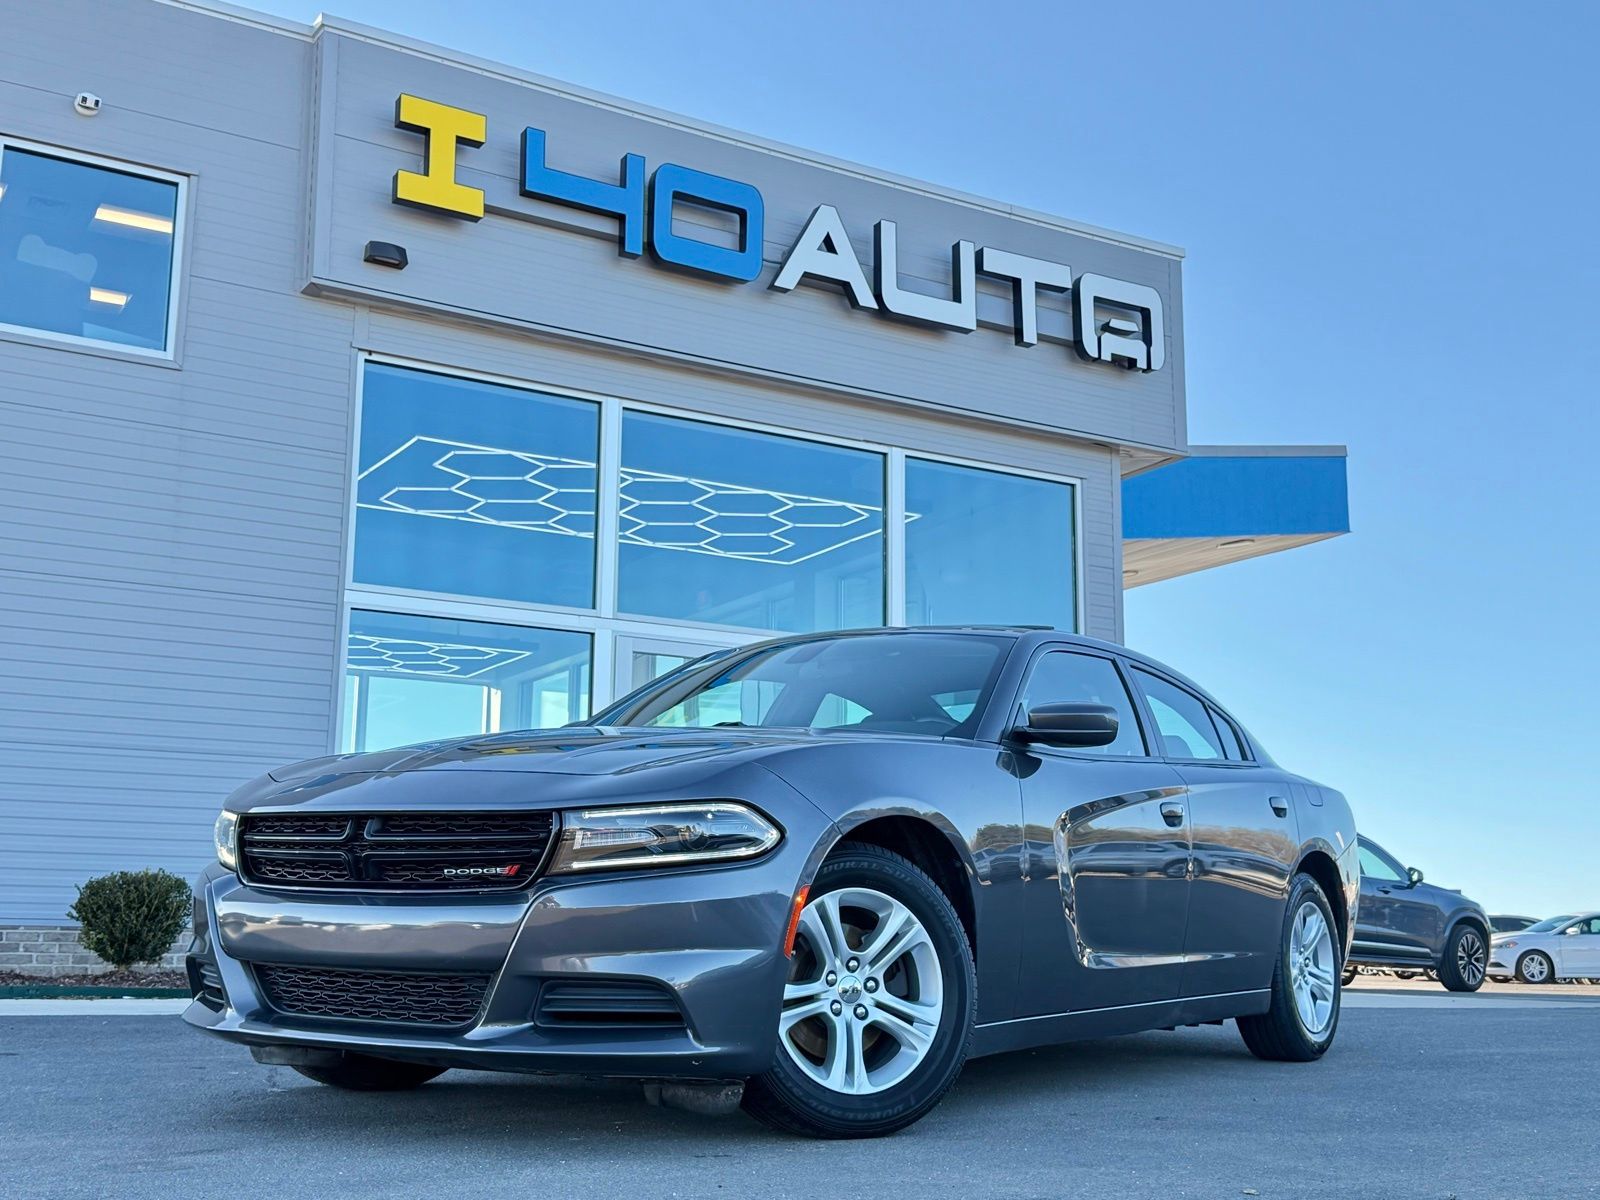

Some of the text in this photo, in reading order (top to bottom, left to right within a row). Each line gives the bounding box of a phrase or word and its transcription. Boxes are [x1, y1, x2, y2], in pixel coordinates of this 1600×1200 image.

[392, 92, 487, 223] I
[519, 126, 764, 283] 40
[443, 867, 508, 875] DODGE
